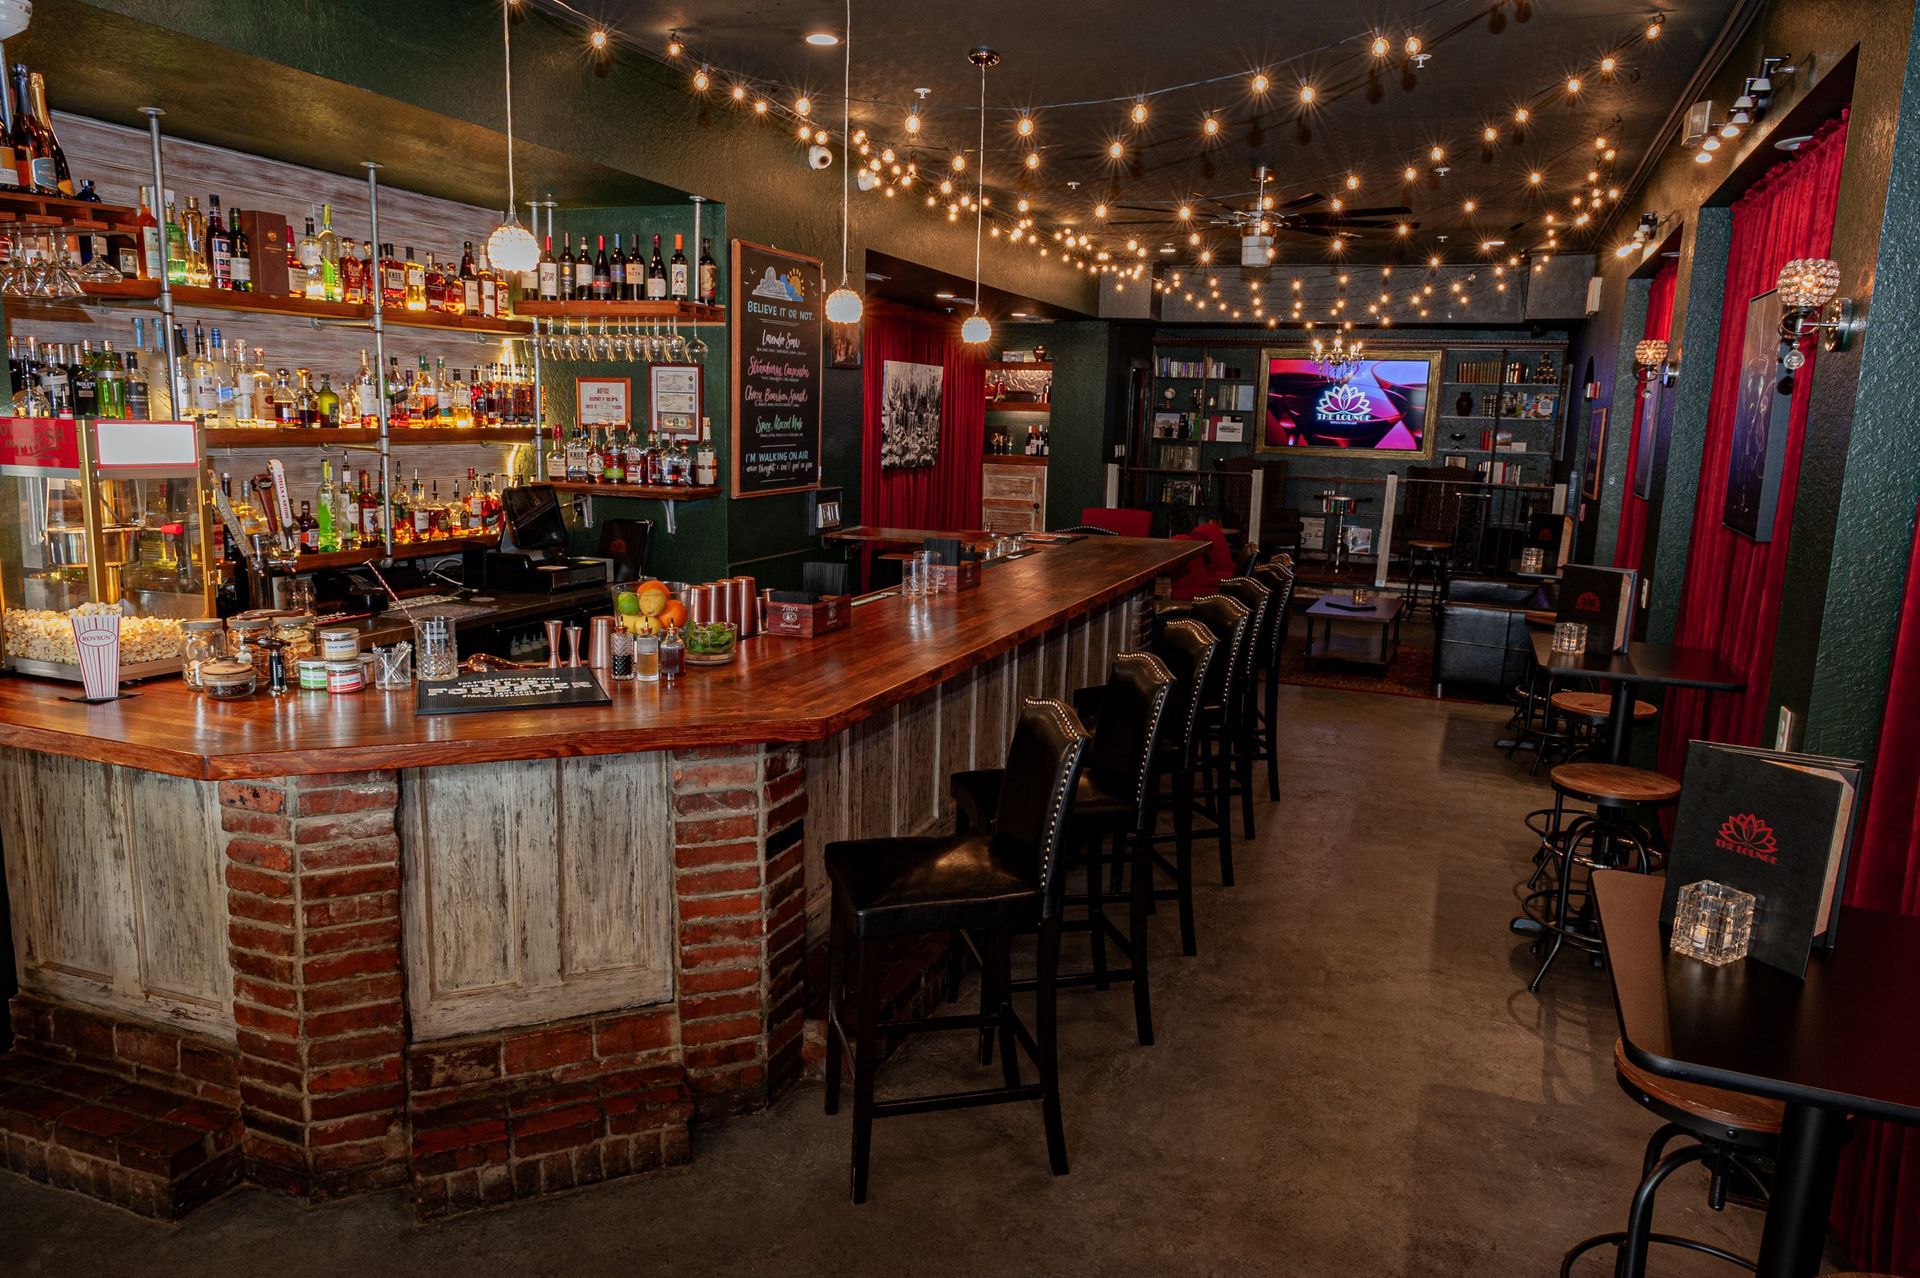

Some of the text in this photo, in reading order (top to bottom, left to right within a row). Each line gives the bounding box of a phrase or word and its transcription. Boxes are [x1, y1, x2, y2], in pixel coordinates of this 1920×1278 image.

[748, 300, 777, 316] BELIEVE
[780, 308, 786, 317] IT
[788, 309, 797, 319] OR
[747, 356, 783, 376] Strawberry
[744, 384, 763, 402] Cherry
[764, 388, 788, 402] Bourbon
[745, 450, 808, 463] I'M WALKING ON AIR
[278, 474, 286, 496] STELLA
[82, 634, 111, 642] ROVSUN
[427, 681, 592, 696] FORESTER
